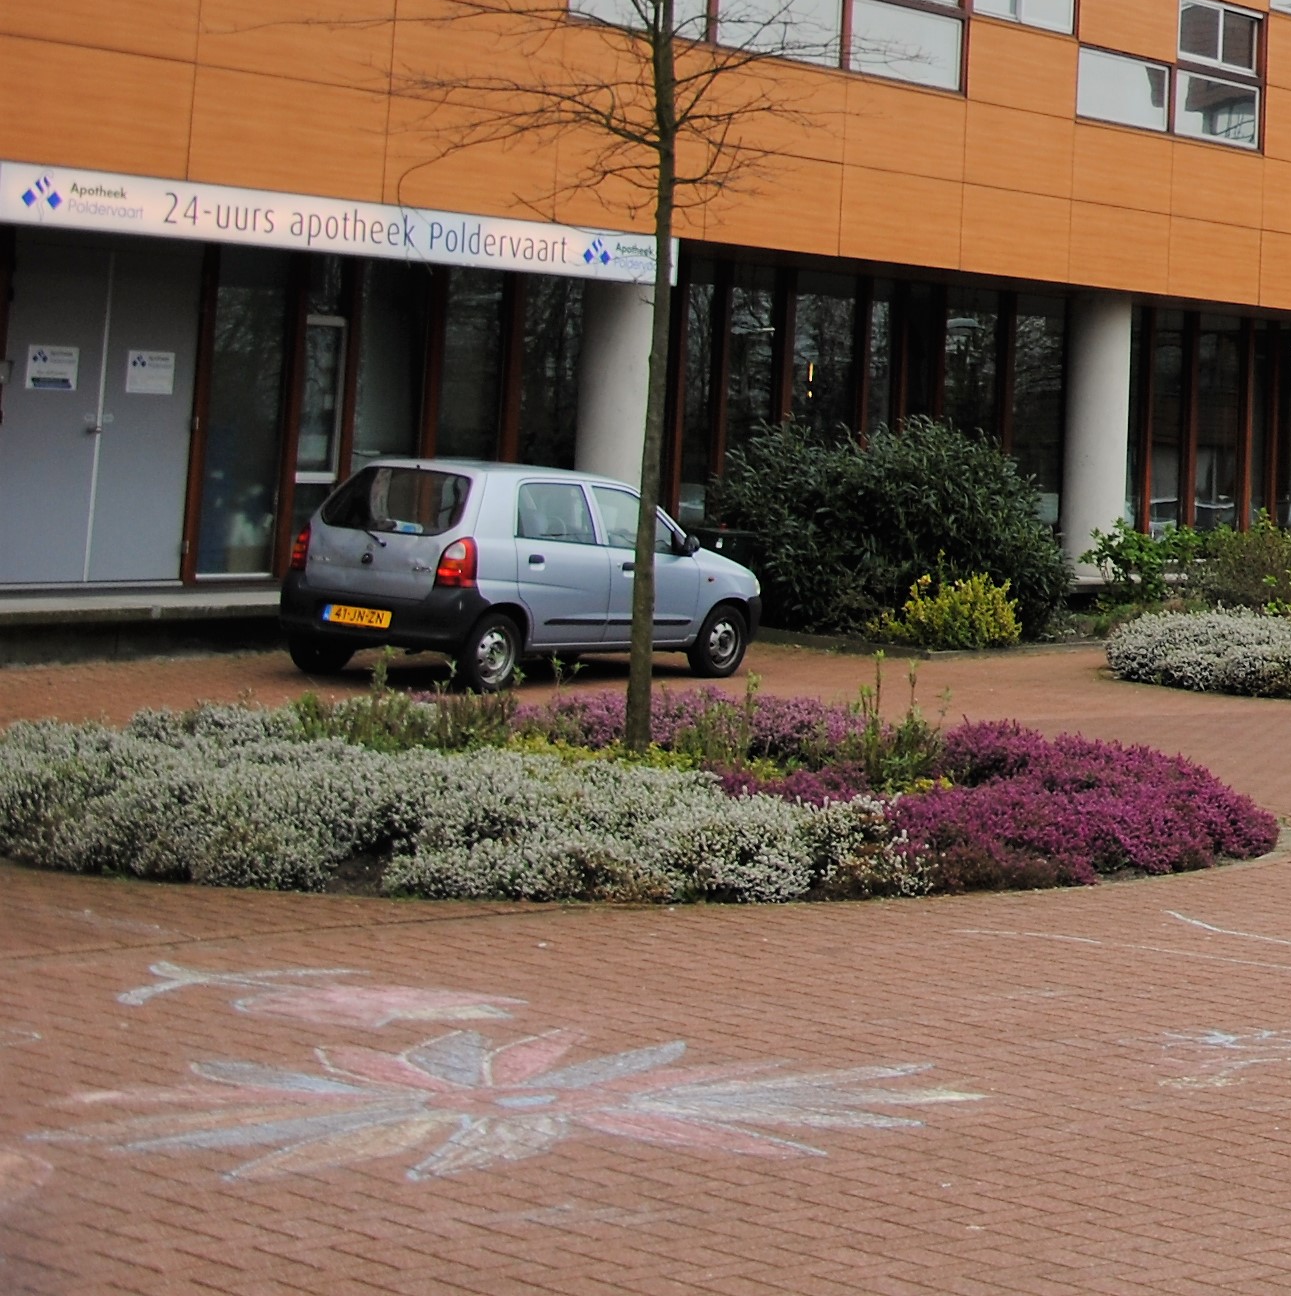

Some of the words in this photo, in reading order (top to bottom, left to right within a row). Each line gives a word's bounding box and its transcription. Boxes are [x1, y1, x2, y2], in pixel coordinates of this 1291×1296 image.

[70, 182, 127, 198] Apotheek
[67, 198, 144, 219] Poldervaart
[163, 191, 275, 234] 24-uurs
[290, 208, 415, 248] apotheek
[429, 221, 567, 264] Poldervaart
